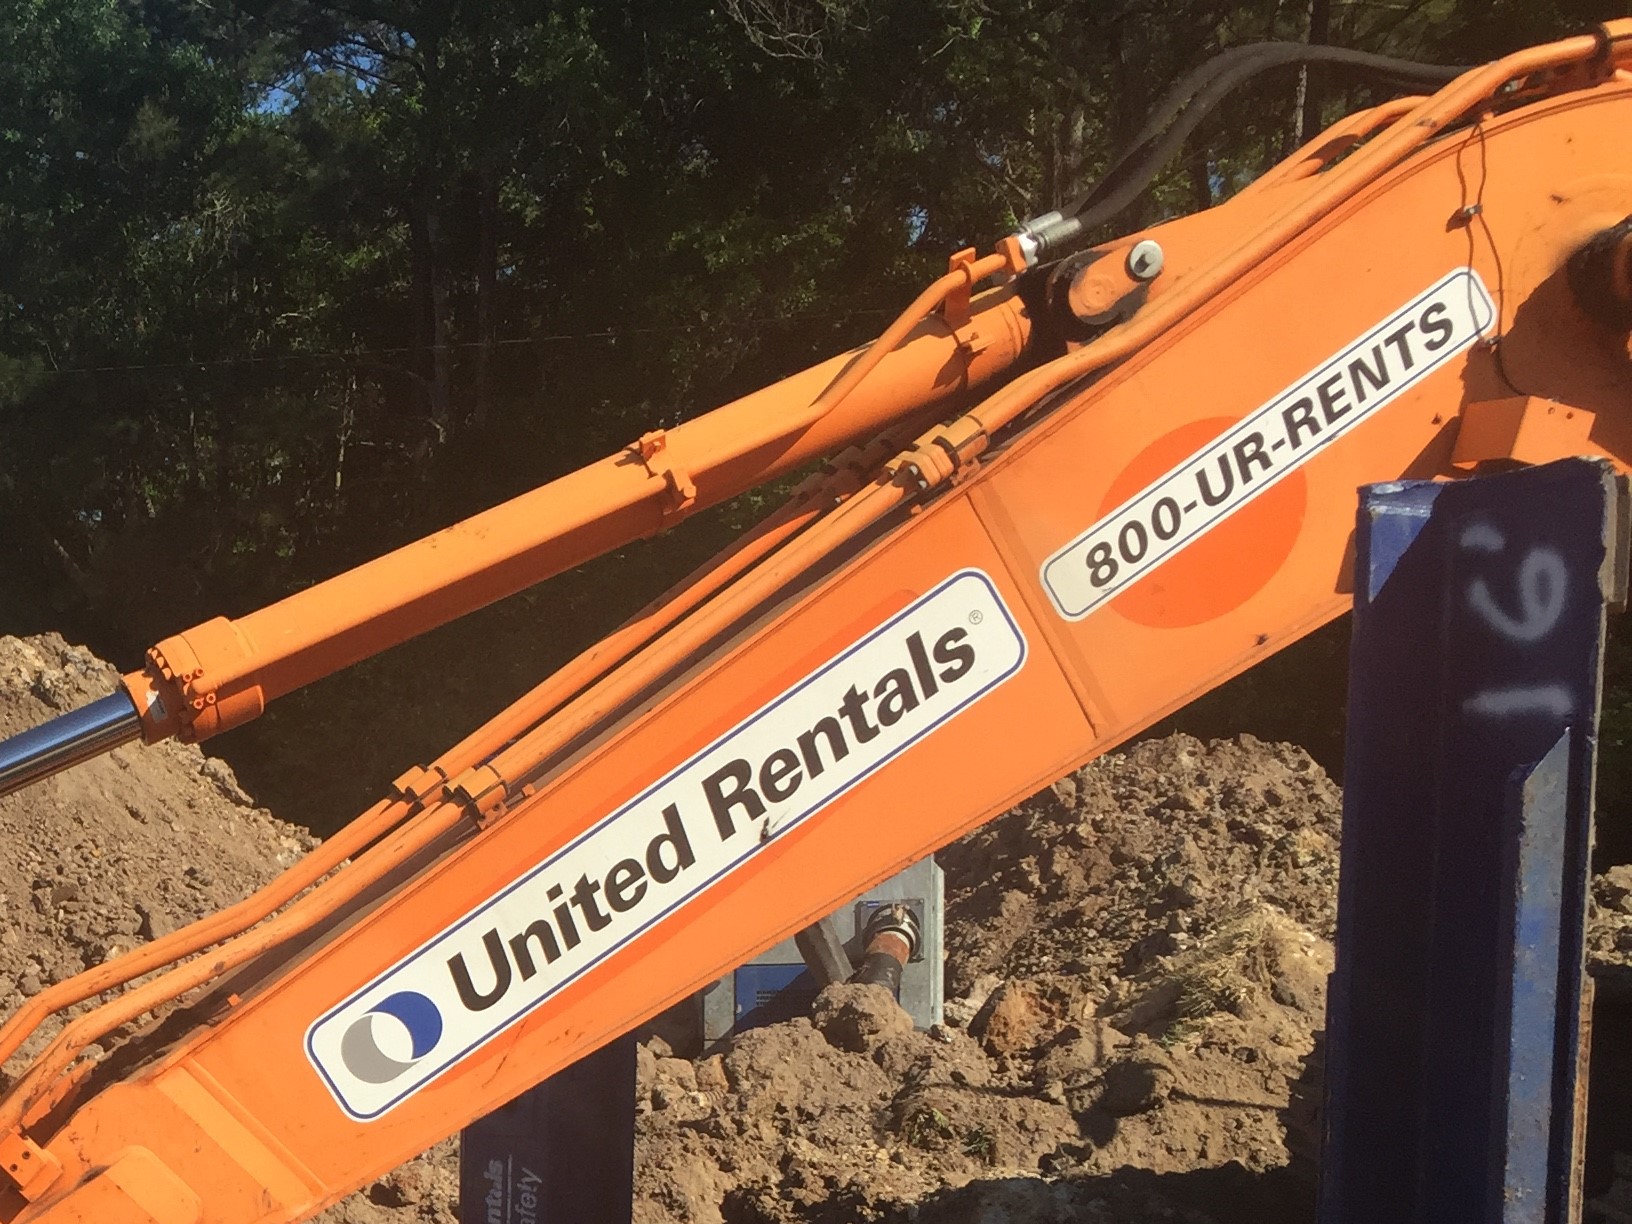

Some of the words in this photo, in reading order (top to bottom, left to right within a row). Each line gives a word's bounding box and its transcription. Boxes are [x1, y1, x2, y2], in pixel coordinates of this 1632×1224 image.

[1085, 302, 1454, 588] 800-UR-RENTS
[448, 803, 696, 1012] United
[702, 620, 976, 840] Rentals
